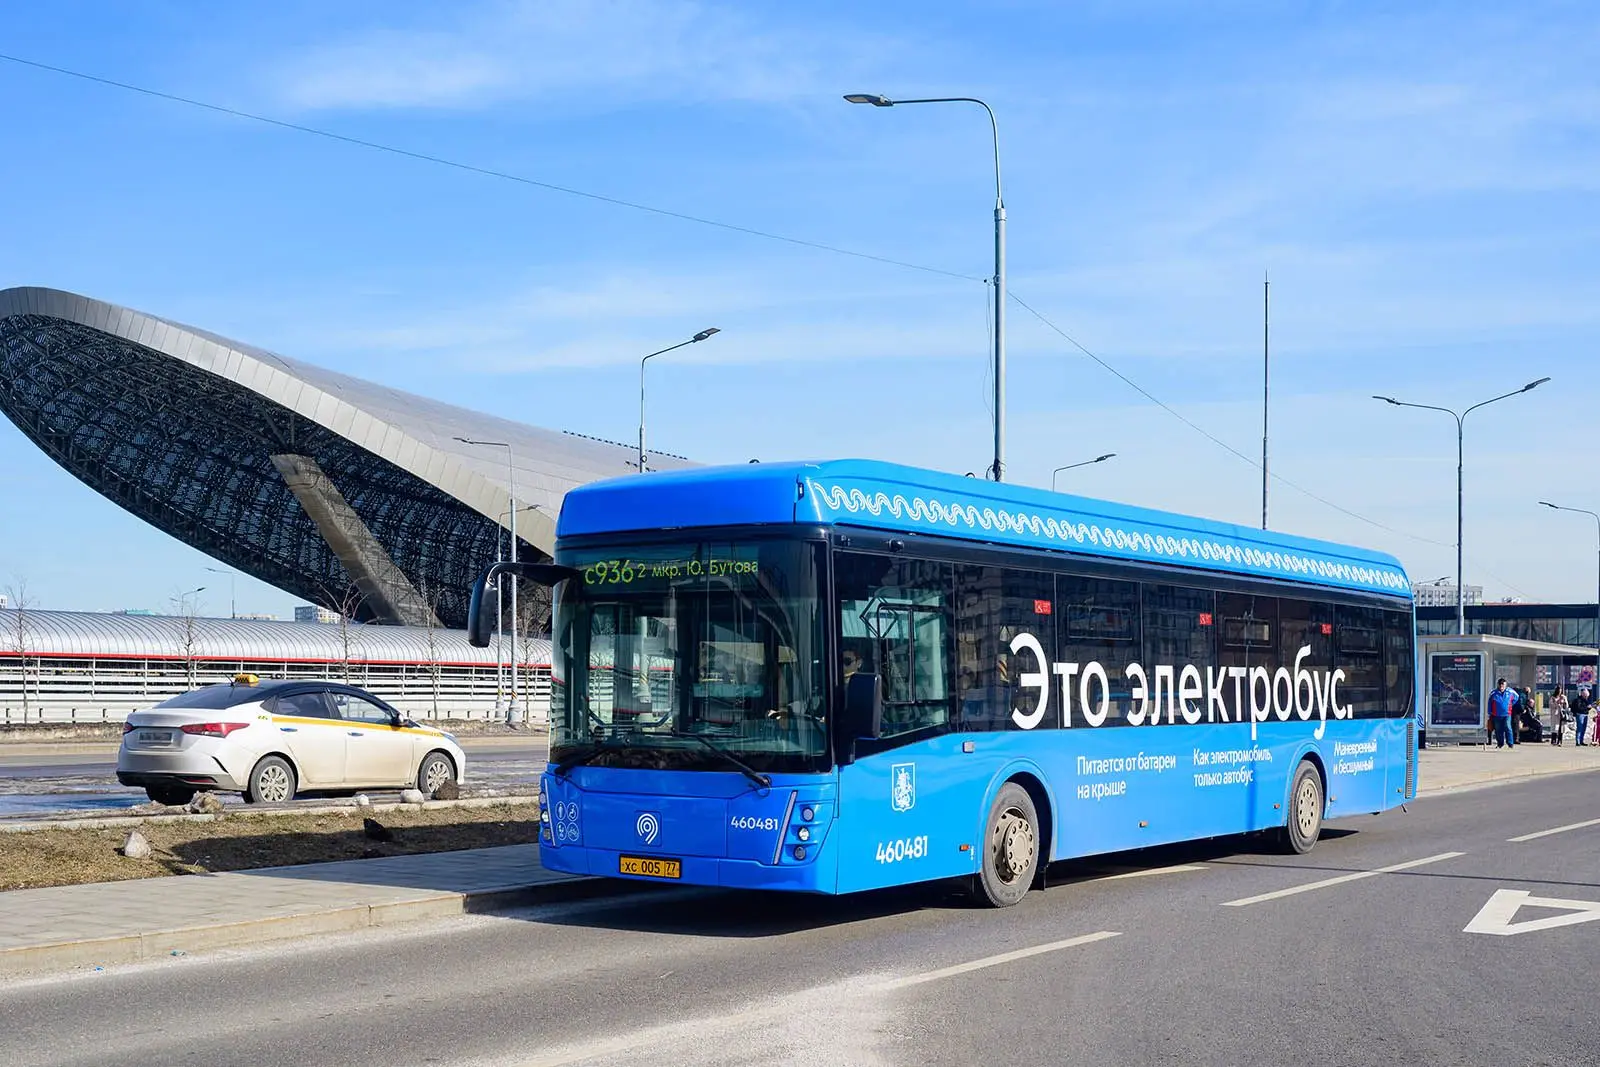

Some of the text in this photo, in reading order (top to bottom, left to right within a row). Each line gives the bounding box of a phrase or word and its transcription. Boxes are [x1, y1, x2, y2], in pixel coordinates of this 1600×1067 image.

[637, 563, 646, 578] 2
[651, 564, 681, 579] мкр.
[686, 560, 704, 575] Ю.
[709, 560, 759, 577] Бутова
[1009, 632, 1353, 740] Это электробус.
[1077, 751, 1176, 776] Питается от батареи
[1193, 744, 1272, 767] Как электромобиль,
[1193, 765, 1254, 787] только автобус
[1077, 780, 1127, 802] на крыше
[731, 816, 779, 831] 460481
[875, 835, 929, 864] 460481
[641, 861, 661, 874] 005
[666, 862, 676, 873] 77
